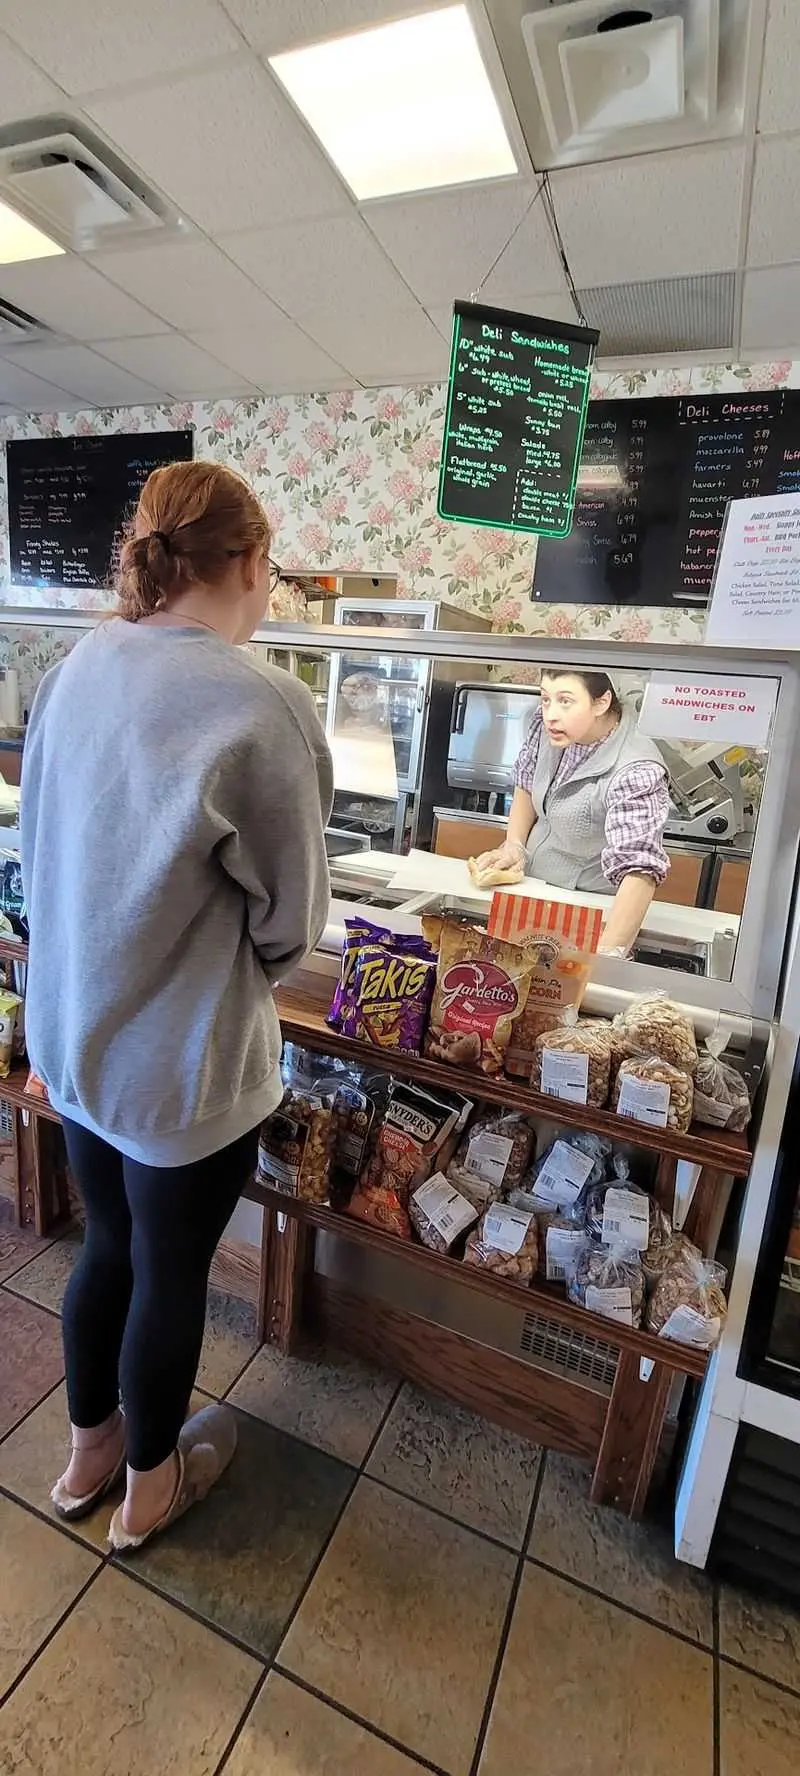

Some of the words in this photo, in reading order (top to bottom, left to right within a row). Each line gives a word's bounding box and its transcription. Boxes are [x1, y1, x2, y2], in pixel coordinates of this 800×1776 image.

[482, 324, 503, 340] Deli
[511, 331, 570, 355] Sandwiches
[498, 350, 514, 361] sub
[487, 399, 502, 409] sub
[687, 404, 711, 418] Deli
[721, 402, 769, 416] Cheeses
[458, 423, 482, 435] Wraps
[697, 431, 745, 447] provolone
[695, 446, 745, 457] mozzarella
[450, 455, 488, 470] Flatbread
[693, 461, 732, 473] farmers
[691, 479, 727, 490] havarti
[577, 500, 605, 511] American
[685, 545, 702, 555] hot
[674, 685, 691, 694] NO
[693, 687, 746, 699] TOASTED
[661, 697, 735, 712] SANDWICHES
[737, 704, 756, 713] ON
[693, 713, 717, 723] EBT
[356, 957, 429, 1007] Takis
[440, 963, 516, 1010] Gardetto's
[389, 1101, 434, 1136] SNYDER'S
